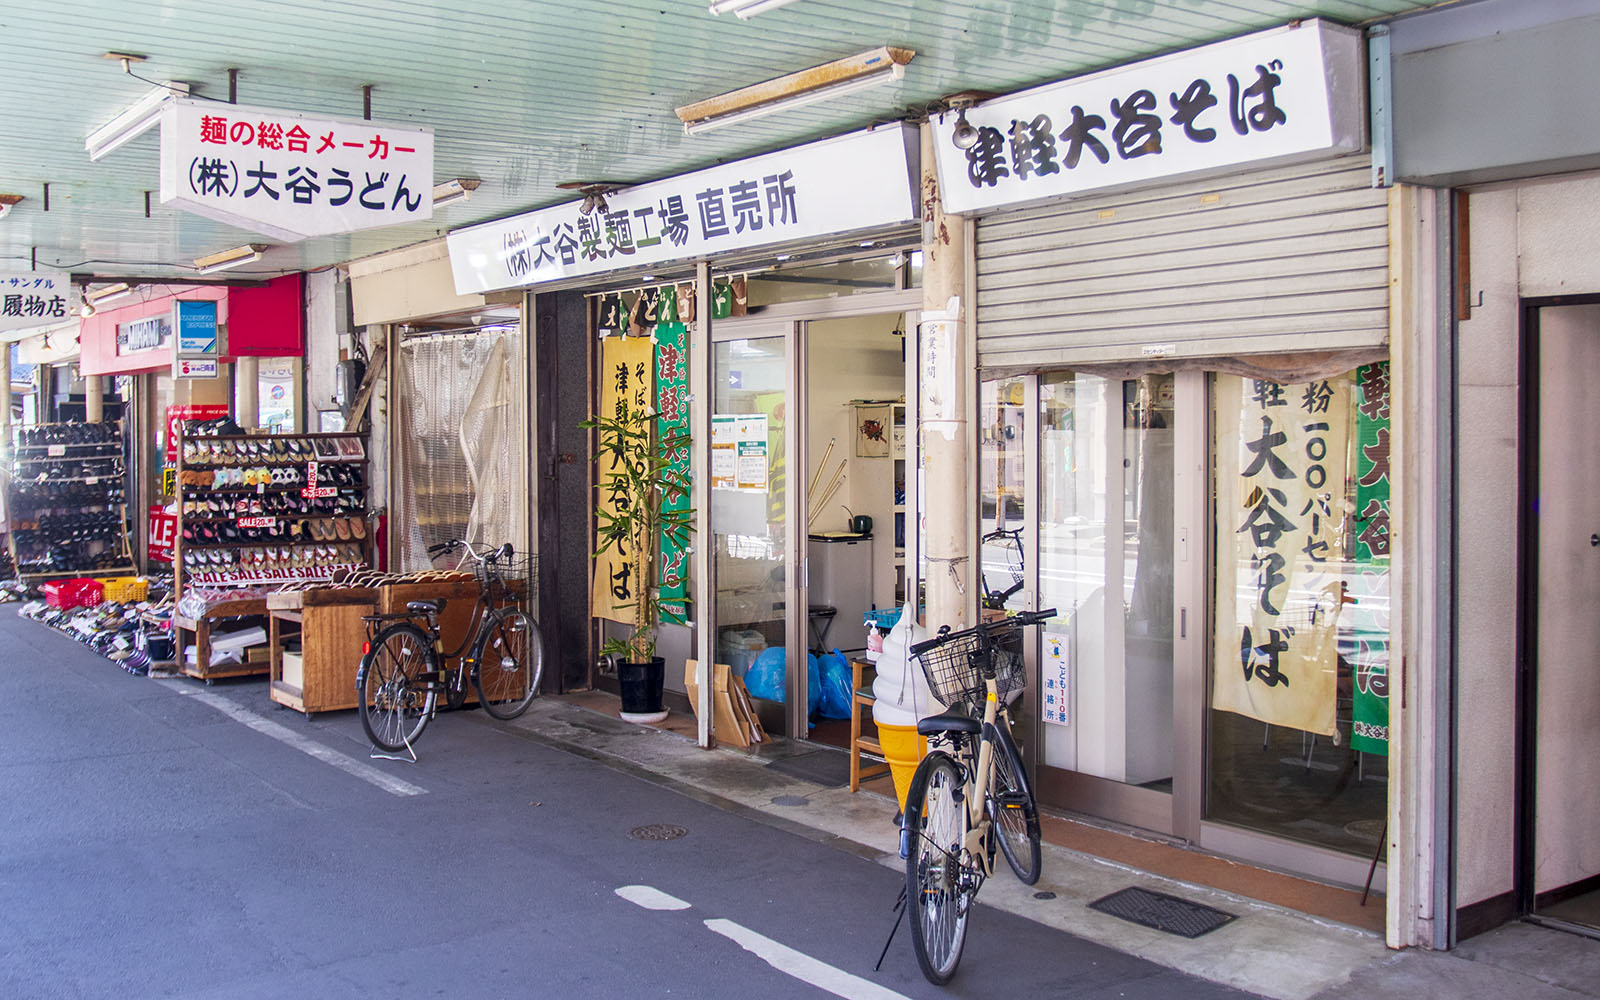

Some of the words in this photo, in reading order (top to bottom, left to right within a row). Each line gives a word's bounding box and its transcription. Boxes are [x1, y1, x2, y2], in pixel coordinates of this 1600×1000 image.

[200, 115, 416, 160] 麺の総合メーカー
[965, 59, 1287, 188] 津軽大谷そば
[189, 156, 422, 212] (株)大谷うどん
[696, 169, 798, 241] 直売所
[239, 518, 256, 526] SALE
[193, 571, 227, 583] SALE
[229, 570, 259, 581] SALE
[264, 567, 296, 580] SALE
[298, 566, 327, 579] SALE
[1046, 678, 1054, 720] 連絡所
